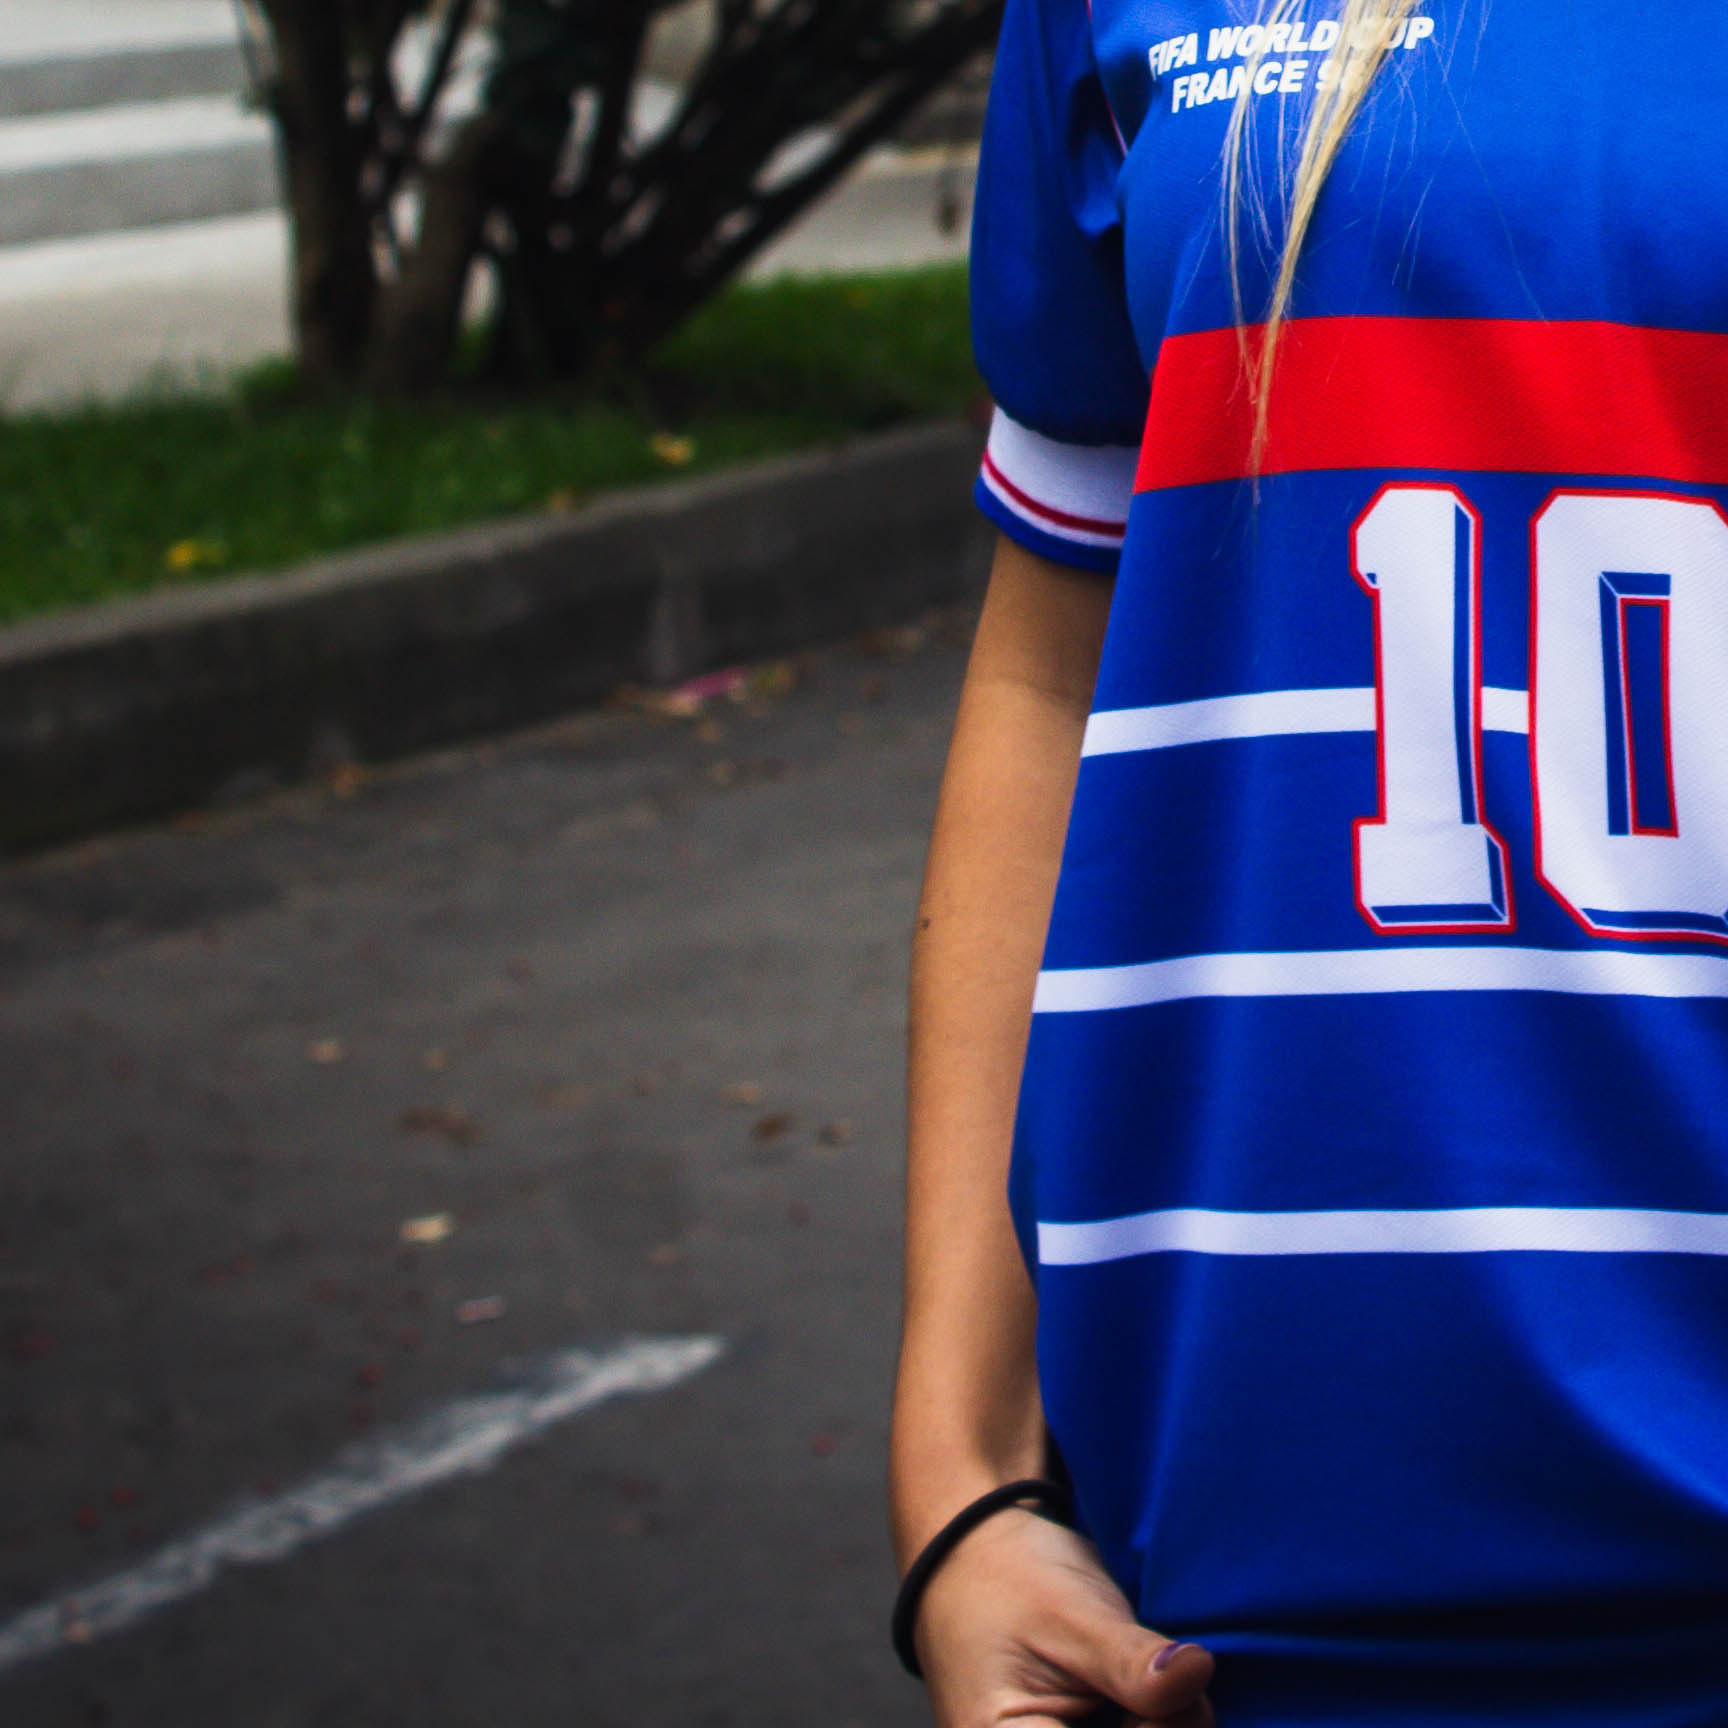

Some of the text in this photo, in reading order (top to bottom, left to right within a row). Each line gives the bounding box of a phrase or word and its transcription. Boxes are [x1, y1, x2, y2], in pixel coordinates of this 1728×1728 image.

[1149, 16, 1435, 82] FIFA WORLD UP
[1171, 59, 1308, 114] FRANCE
